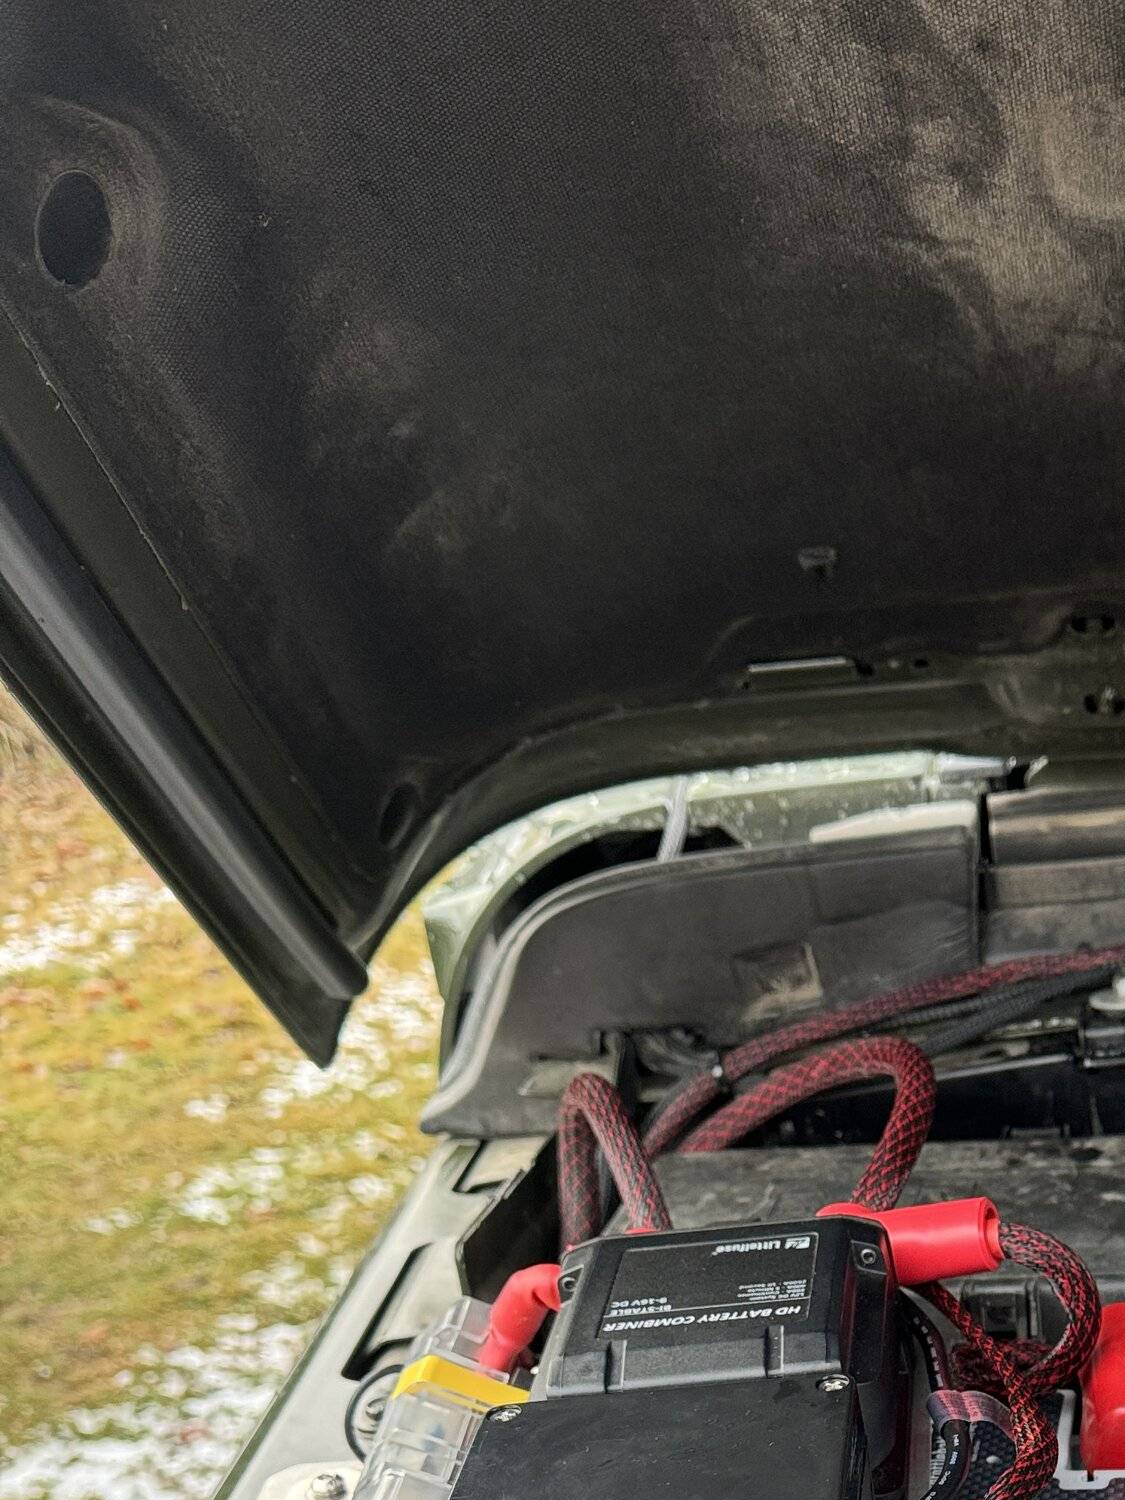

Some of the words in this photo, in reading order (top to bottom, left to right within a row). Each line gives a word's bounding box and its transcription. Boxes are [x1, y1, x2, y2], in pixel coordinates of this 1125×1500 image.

[714, 1240, 781, 1254] Littelfuse
[609, 1304, 672, 1316] BI-STABLE
[610, 1300, 629, 1308] DC
[774, 1305, 801, 1316] HD
[698, 1307, 774, 1325] BATTERY
[603, 1315, 696, 1332] COMBINER
